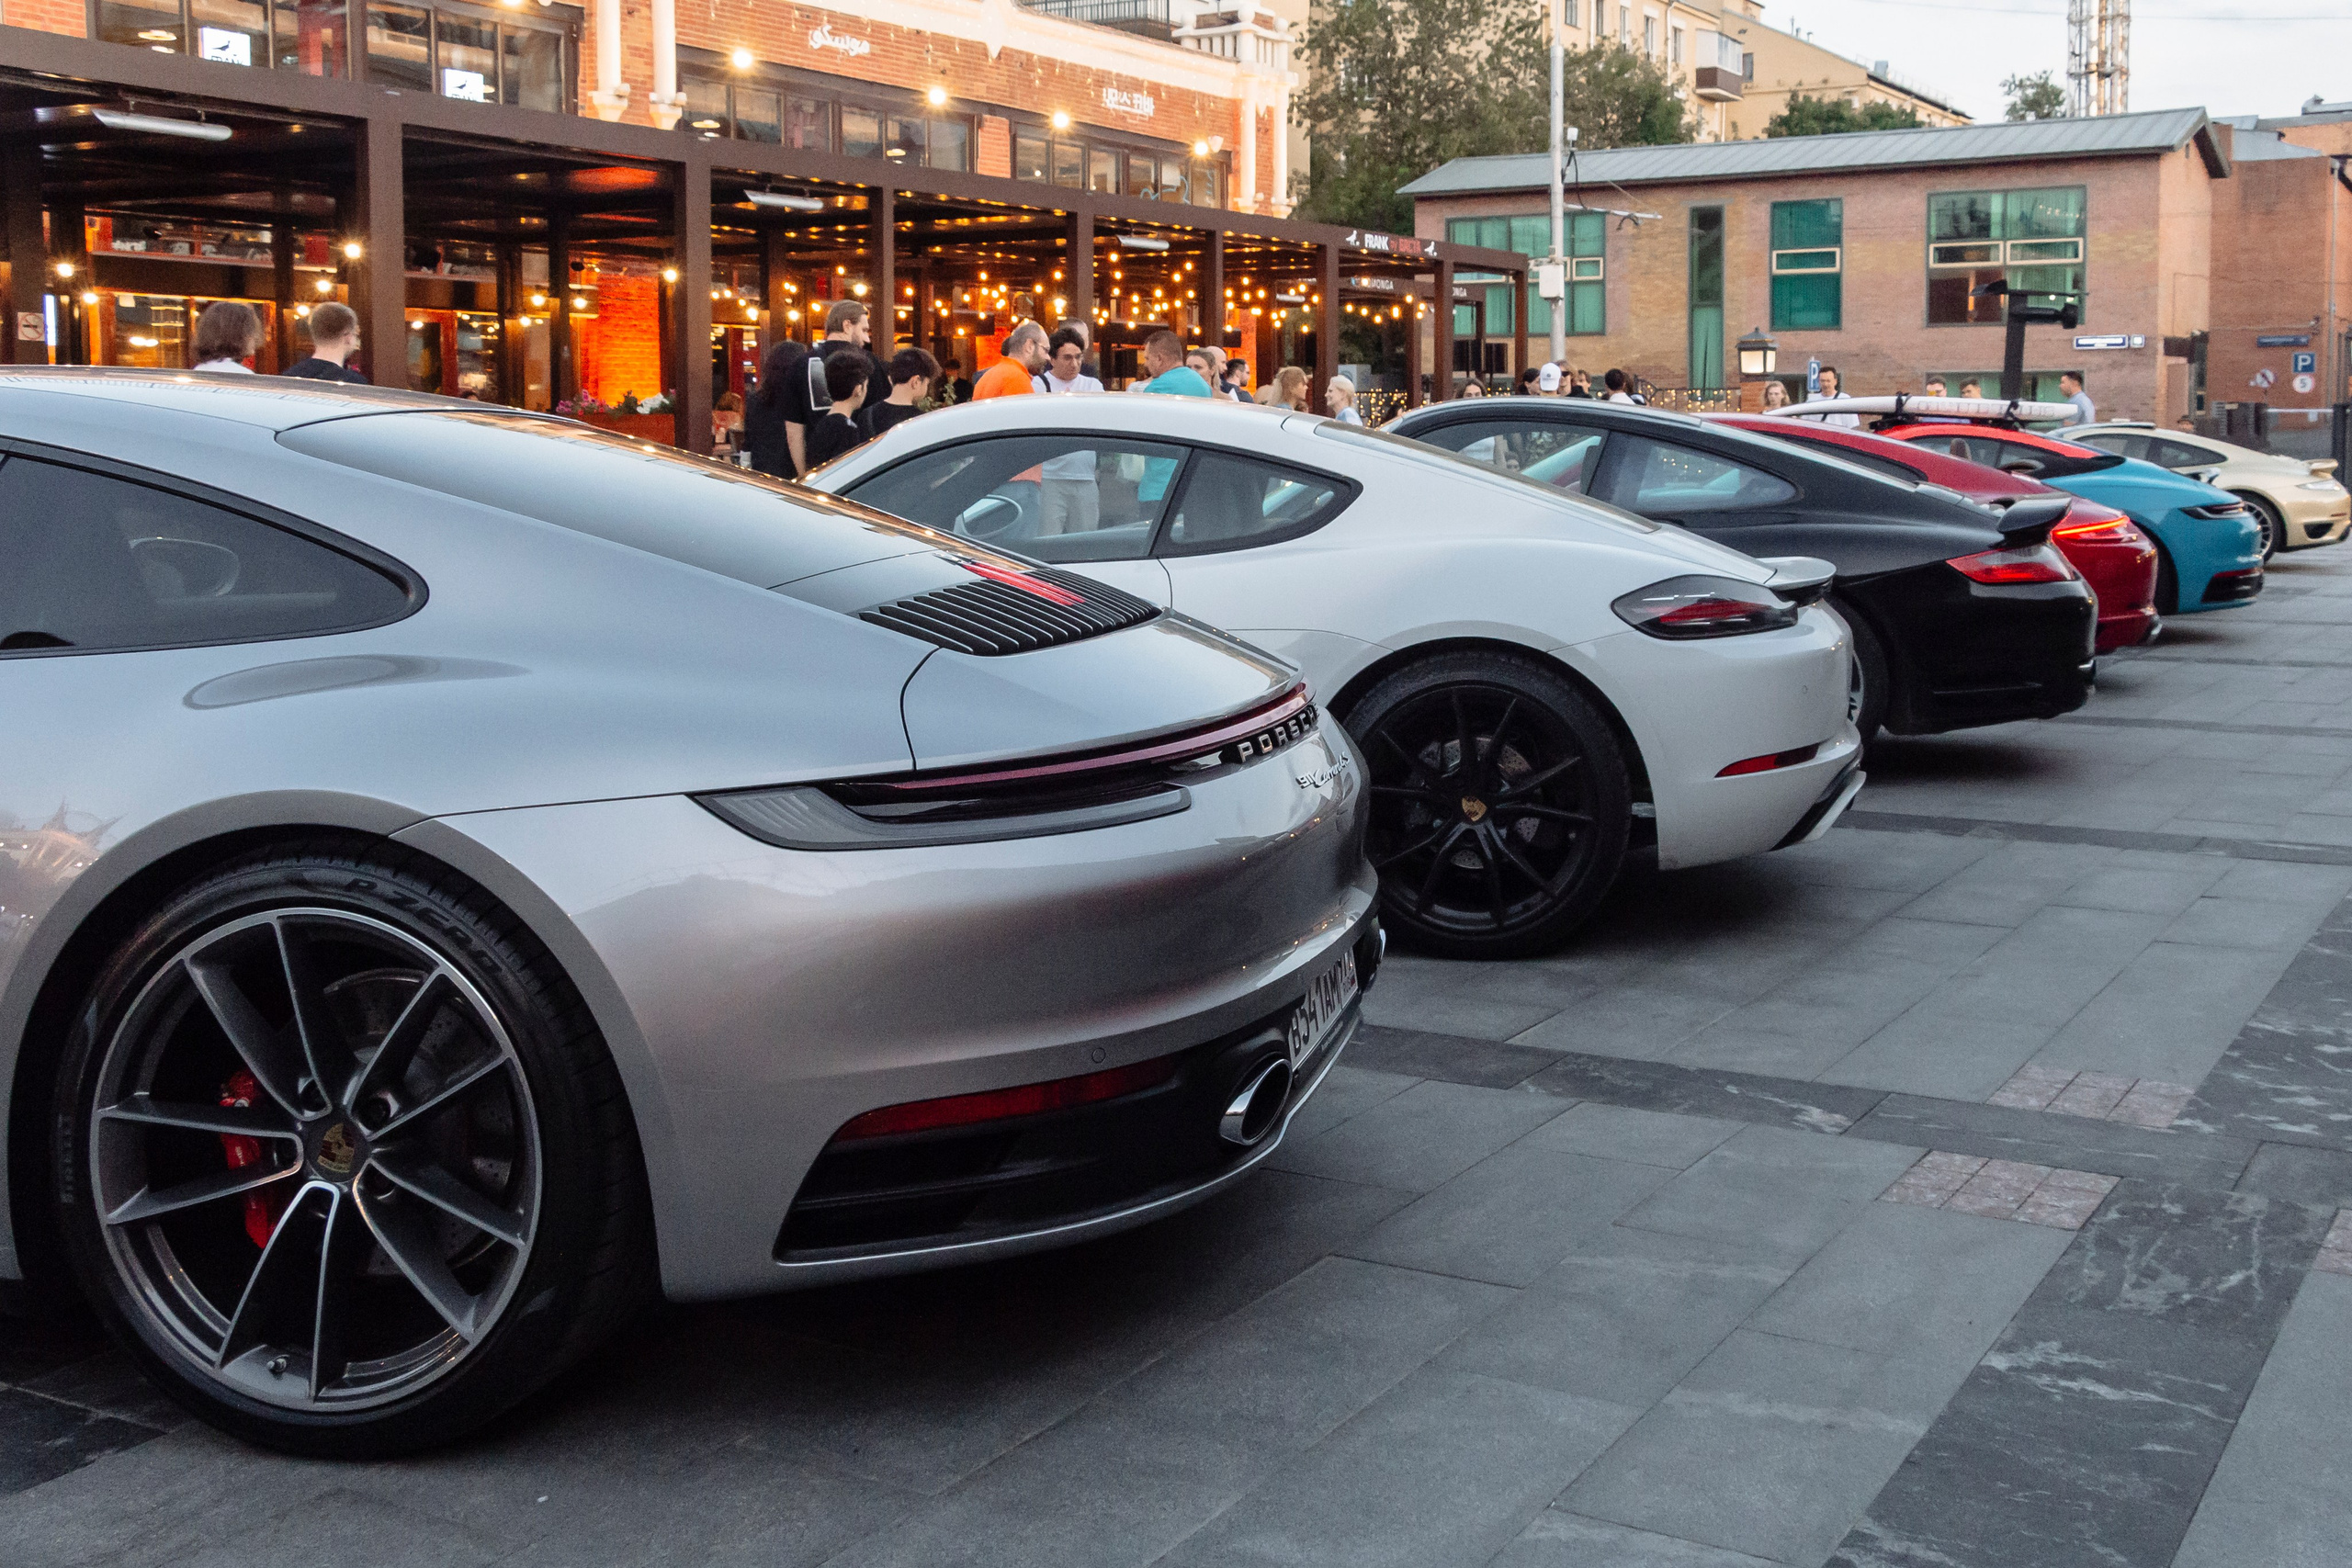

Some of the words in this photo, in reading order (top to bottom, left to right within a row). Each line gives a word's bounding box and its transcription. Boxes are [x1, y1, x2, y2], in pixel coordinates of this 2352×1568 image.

[1363, 232, 1389, 251] FRANK
[2298, 355, 2312, 372] P
[1811, 363, 1819, 388] P
